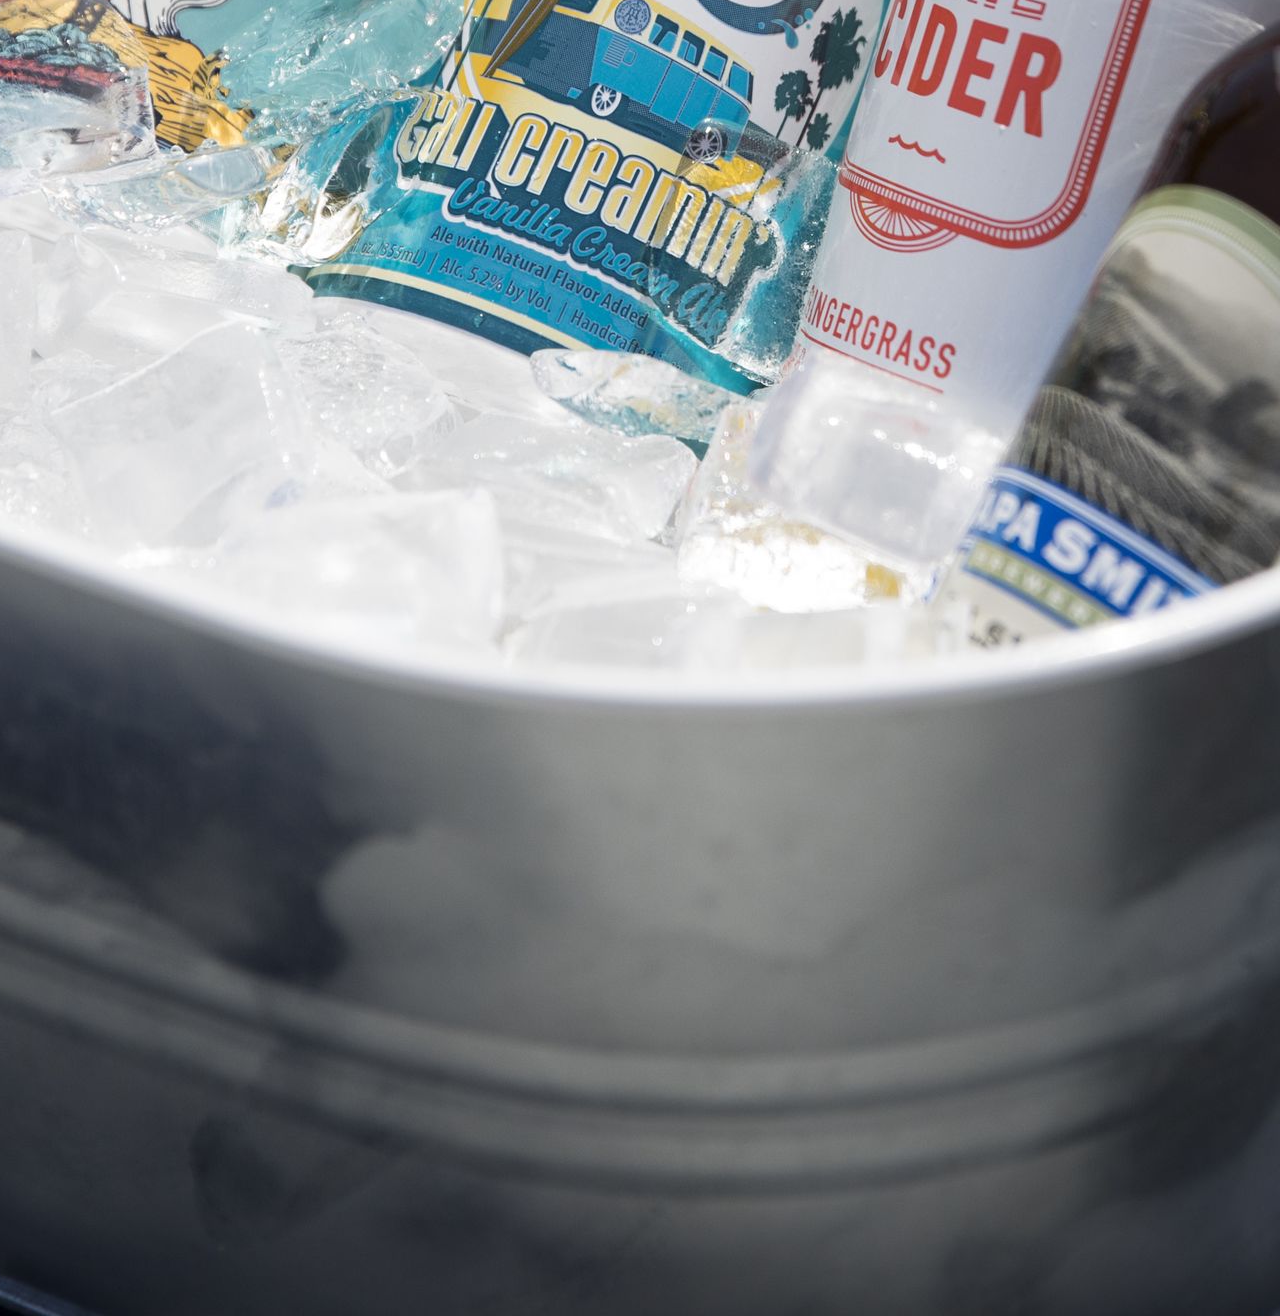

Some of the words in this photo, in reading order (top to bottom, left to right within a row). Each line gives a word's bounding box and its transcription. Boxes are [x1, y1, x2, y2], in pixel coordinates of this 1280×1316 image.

[376, 240, 428, 270] (355mL)
[439, 258, 465, 280] Alc.
[468, 266, 503, 293] 5.2%
[505, 281, 526, 304] by
[526, 290, 552, 314] Vol.
[430, 223, 454, 250] Ale
[456, 232, 490, 258] with
[491, 244, 551, 282] Natural
[551, 267, 601, 304] Flavor
[600, 292, 650, 330] Added
[448, 177, 574, 249] Vanilla
[569, 225, 680, 308] Cream
[1040, 518, 1185, 618] SMI
